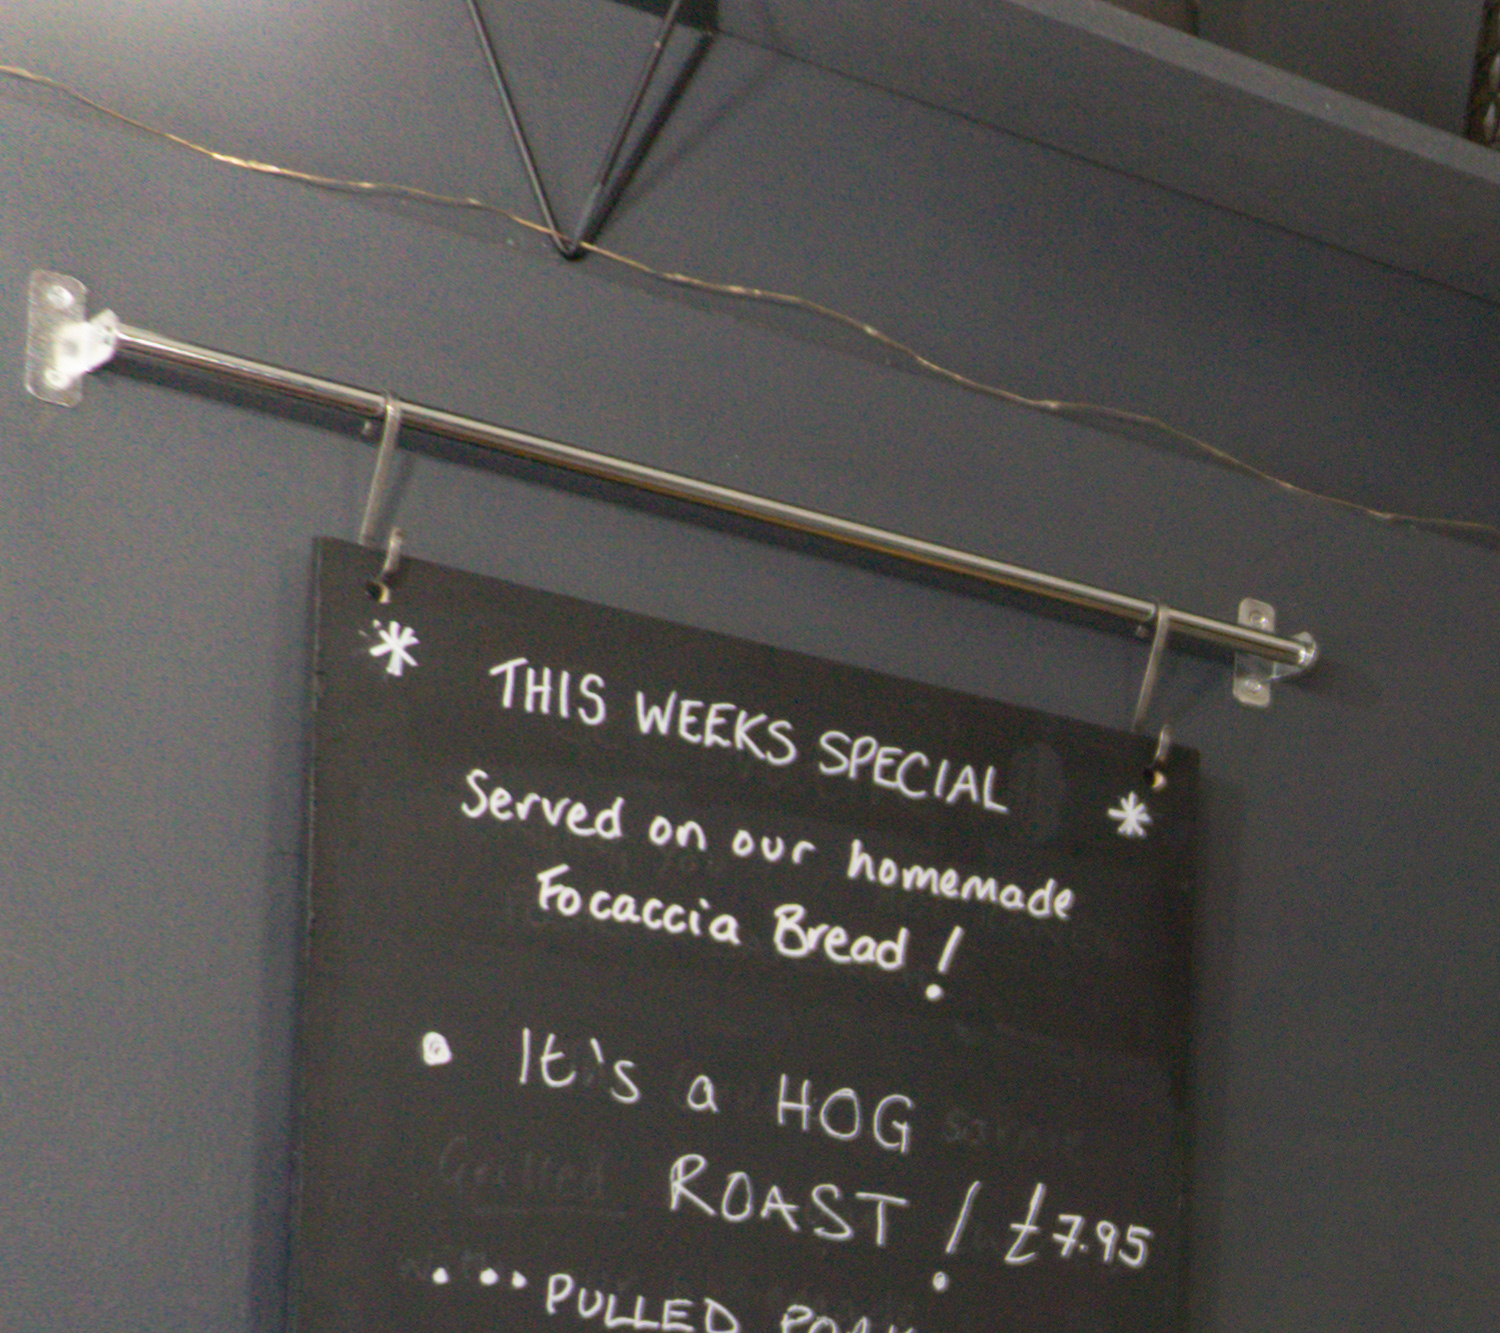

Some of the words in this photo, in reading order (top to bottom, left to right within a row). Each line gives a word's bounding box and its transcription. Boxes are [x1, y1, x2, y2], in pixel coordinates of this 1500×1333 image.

[489, 657, 606, 726] THIS
[635, 691, 797, 766] WEEKS
[818, 729, 1008, 813] SPECIAL
[460, 768, 624, 840] Served
[648, 815, 706, 850] on
[731, 829, 815, 864] our
[846, 838, 1073, 919] homemade
[536, 863, 741, 945] Focaccia
[518, 1027, 640, 1104] It's
[687, 1074, 718, 1112] a
[776, 1073, 913, 1154] HOG
[1004, 1182, 1152, 1268] £7.95
